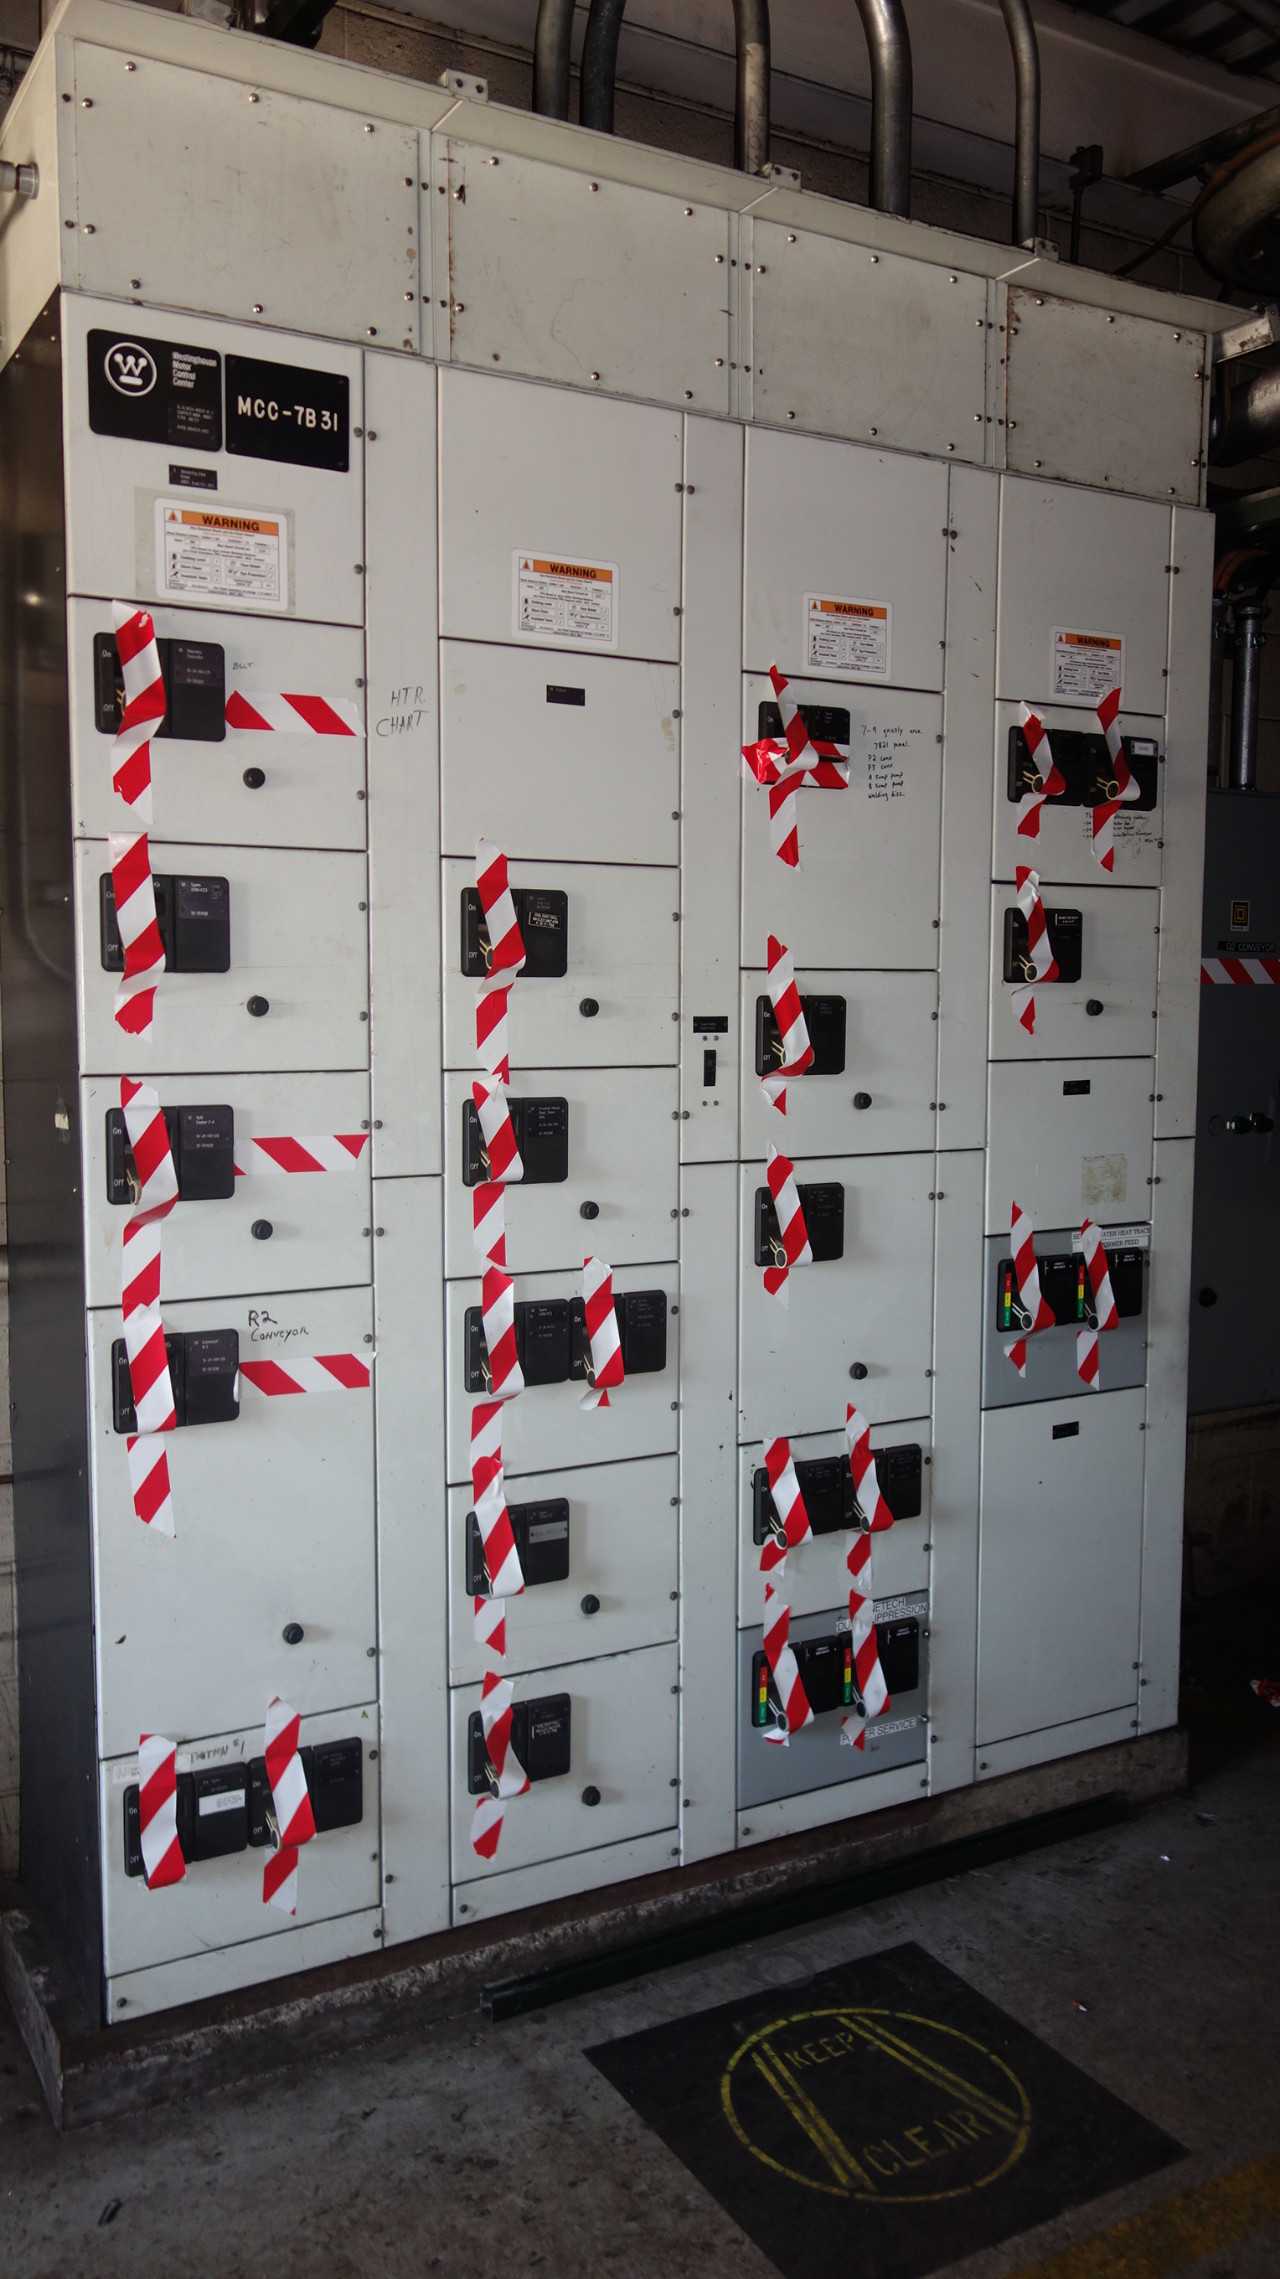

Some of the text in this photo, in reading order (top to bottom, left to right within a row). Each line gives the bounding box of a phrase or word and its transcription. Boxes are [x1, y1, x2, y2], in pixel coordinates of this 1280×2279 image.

[237, 395, 338, 432] MCC-7B31
[201, 515, 260, 532] WARNING
[549, 563, 597, 579] WARNING
[833, 604, 875, 617] WARNING
[376, 709, 431, 737] CHART
[248, 1310, 278, 1327] R2
[783, 2032, 856, 2069] KEEP
[863, 2110, 993, 2176] CLEAR
